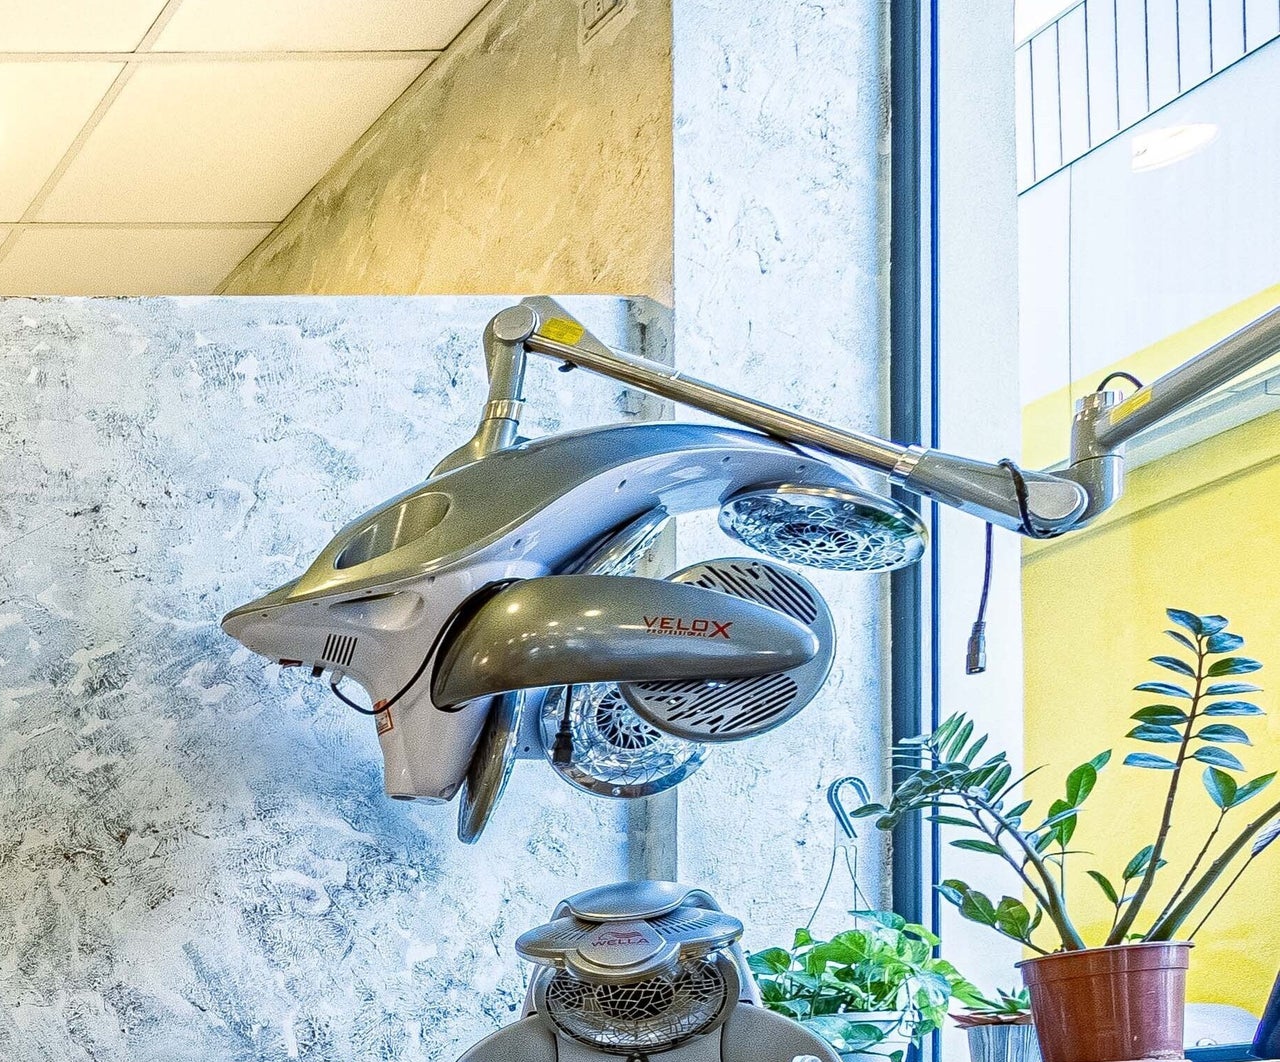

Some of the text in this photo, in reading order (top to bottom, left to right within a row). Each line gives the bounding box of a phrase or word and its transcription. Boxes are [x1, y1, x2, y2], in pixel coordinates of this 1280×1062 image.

[643, 616, 734, 639] VELOX
[646, 629, 707, 638] PROFESSIONAL
[591, 938, 650, 947] WELLA
